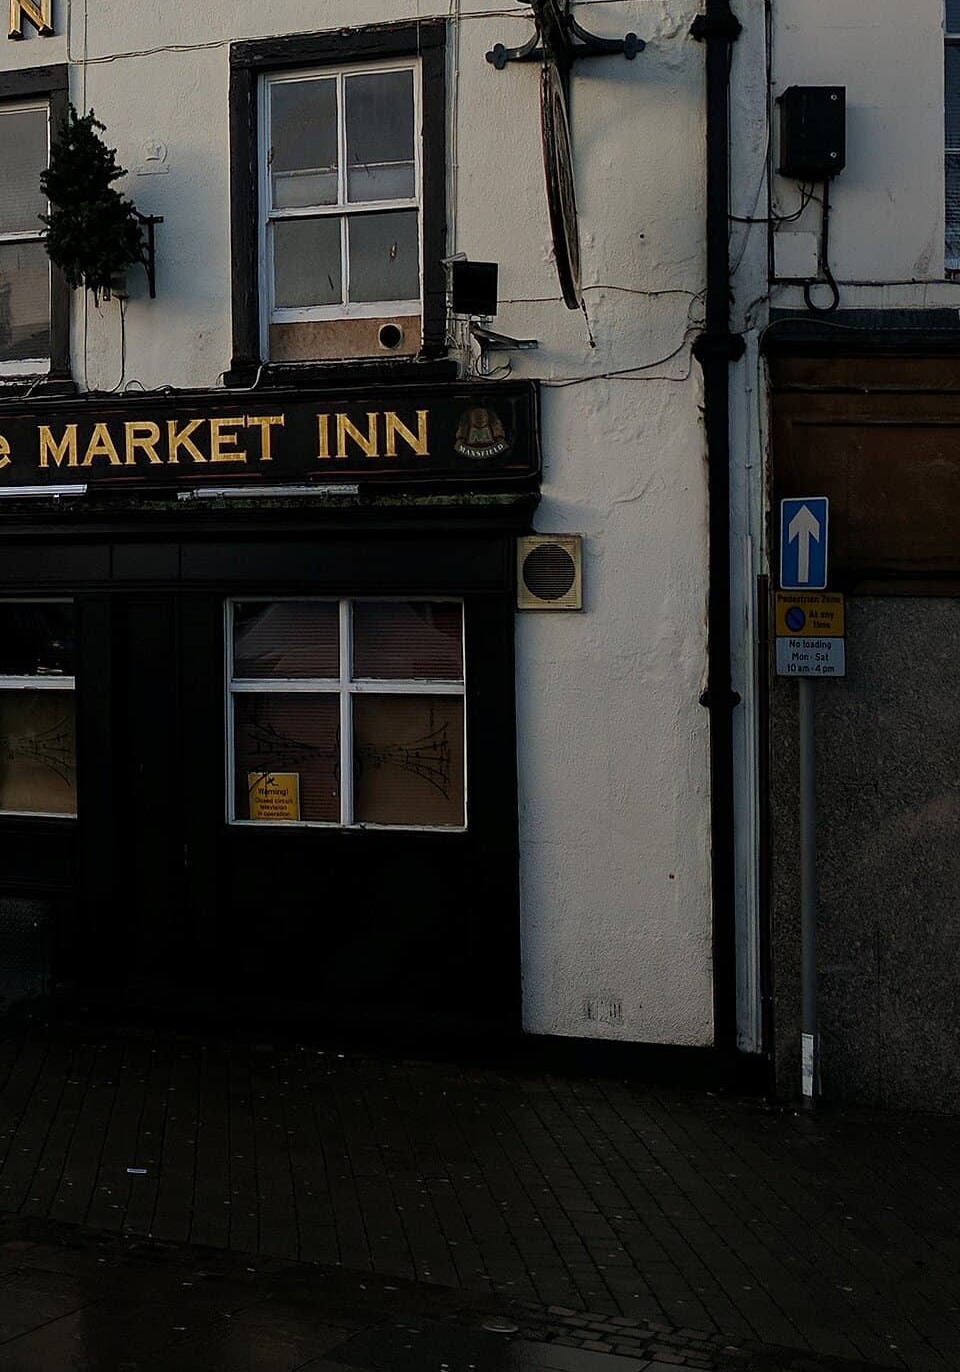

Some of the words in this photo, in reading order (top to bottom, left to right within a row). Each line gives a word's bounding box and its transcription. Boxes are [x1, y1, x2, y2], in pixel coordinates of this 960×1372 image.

[37, 412, 286, 469] MARKET
[315, 408, 431, 460] INN
[459, 442, 505, 457] MANSFIELD
[789, 639, 801, 648] No
[802, 639, 832, 650] loading
[791, 652, 809, 661] Mon
[815, 652, 829, 661] Sat
